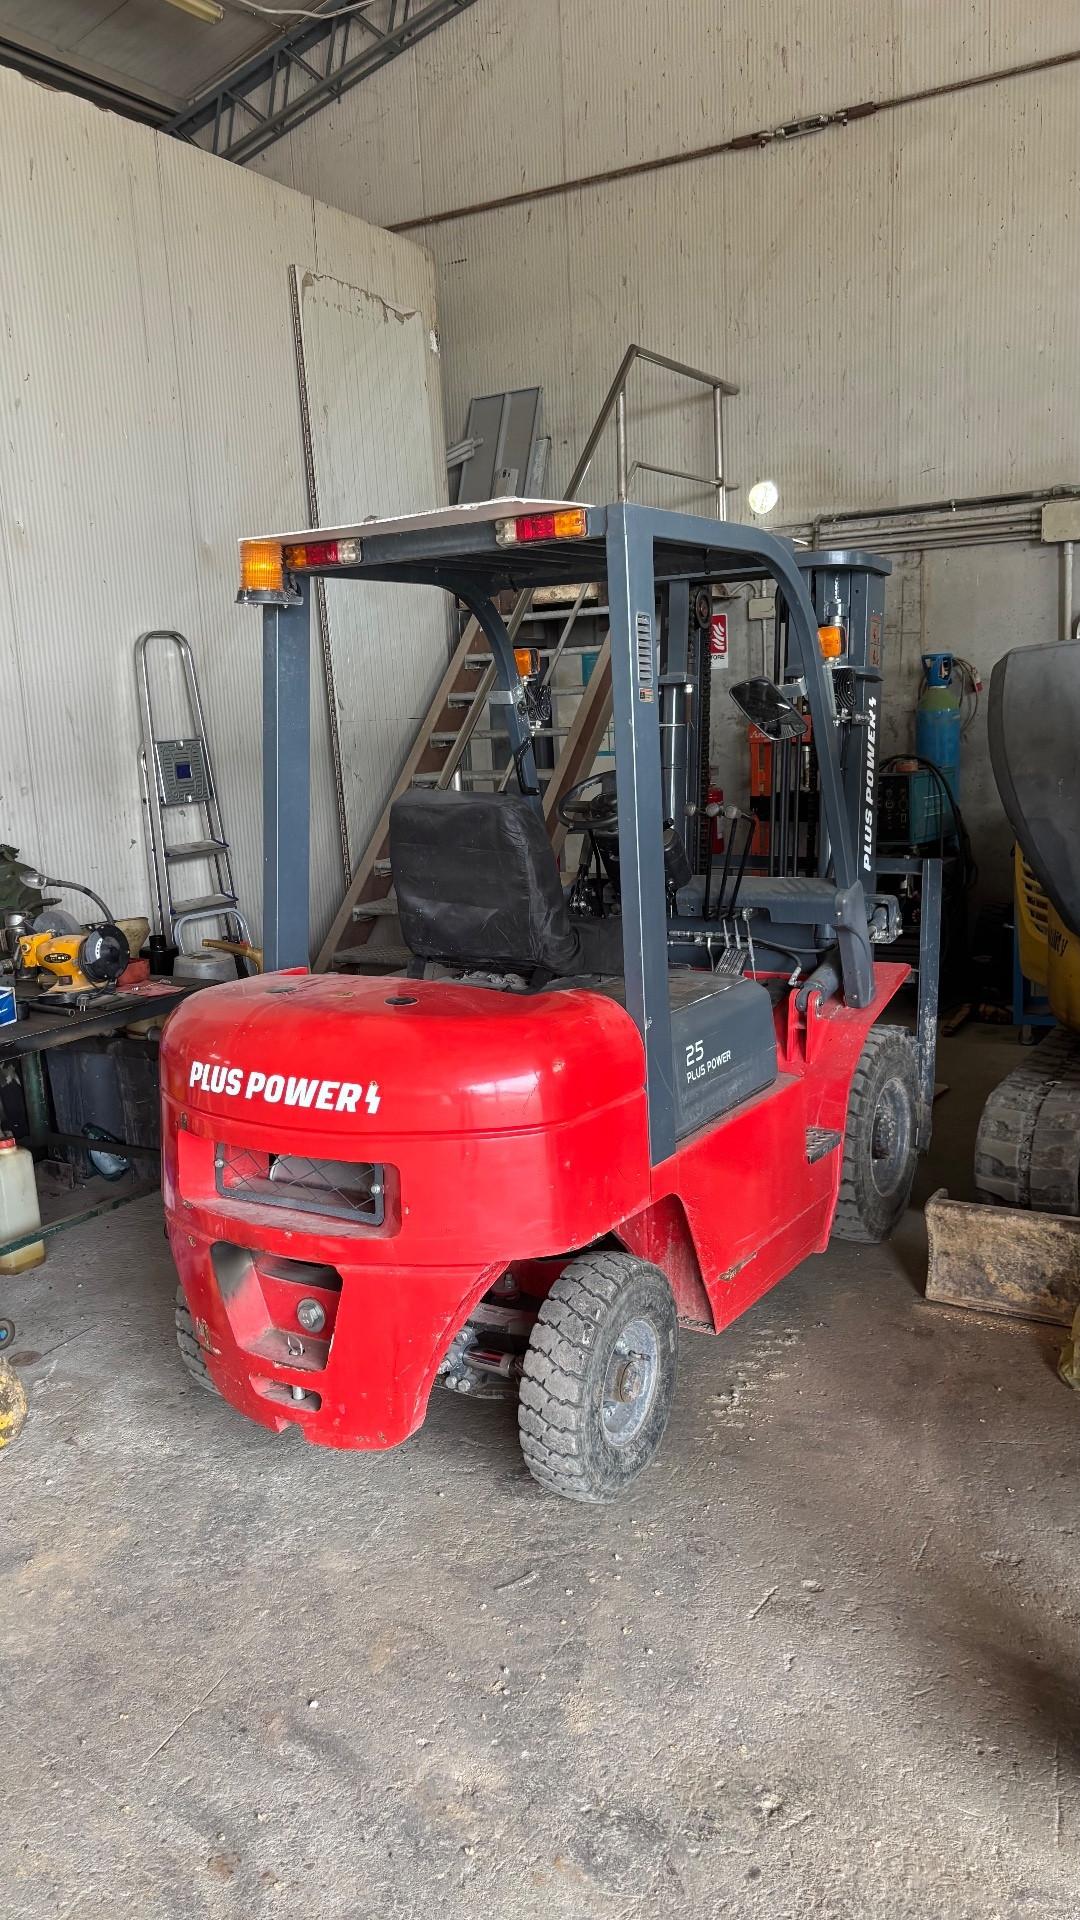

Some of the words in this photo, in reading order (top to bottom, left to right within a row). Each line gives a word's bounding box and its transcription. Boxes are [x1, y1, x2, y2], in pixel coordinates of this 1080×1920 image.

[865, 709, 877, 806] POWER
[863, 808, 874, 872] PLUS
[685, 1039, 704, 1067] 25
[686, 1064, 706, 1084] PLUS
[706, 1050, 732, 1072] POWER
[189, 1060, 244, 1096] PLUS
[245, 1072, 363, 1112] POWER
